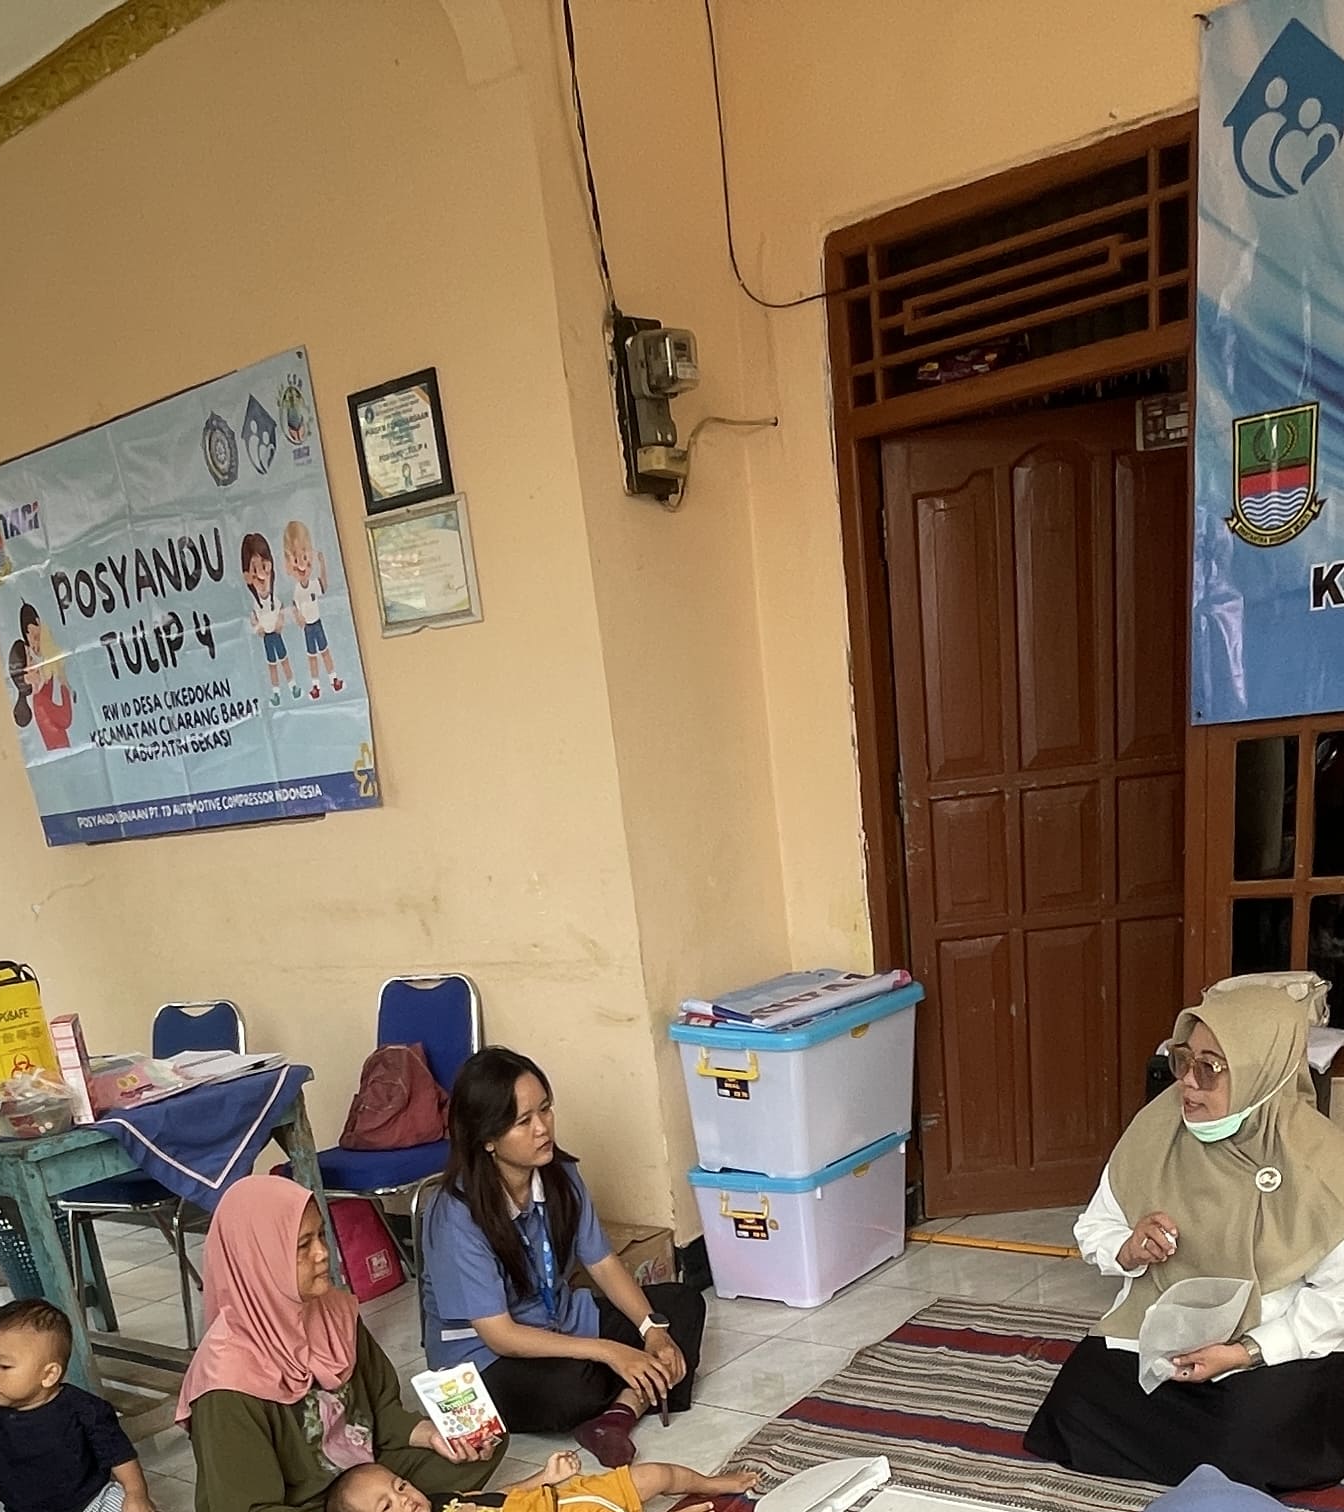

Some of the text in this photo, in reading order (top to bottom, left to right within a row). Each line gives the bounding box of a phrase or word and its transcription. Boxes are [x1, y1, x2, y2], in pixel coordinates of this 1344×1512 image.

[50, 527, 224, 626] POSYANDU
[100, 611, 216, 680] TULIP 4
[90, 720, 158, 748] KECAMATAN
[220, 698, 260, 724] BARAT
[102, 702, 119, 721] RW
[135, 693, 162, 717] DESA
[164, 678, 232, 710] CIKEDOKAN
[172, 797, 222, 816] AUTOMOTIVE
[222, 790, 275, 810] COMPRESSOR
[275, 784, 323, 802] INDONESIA
